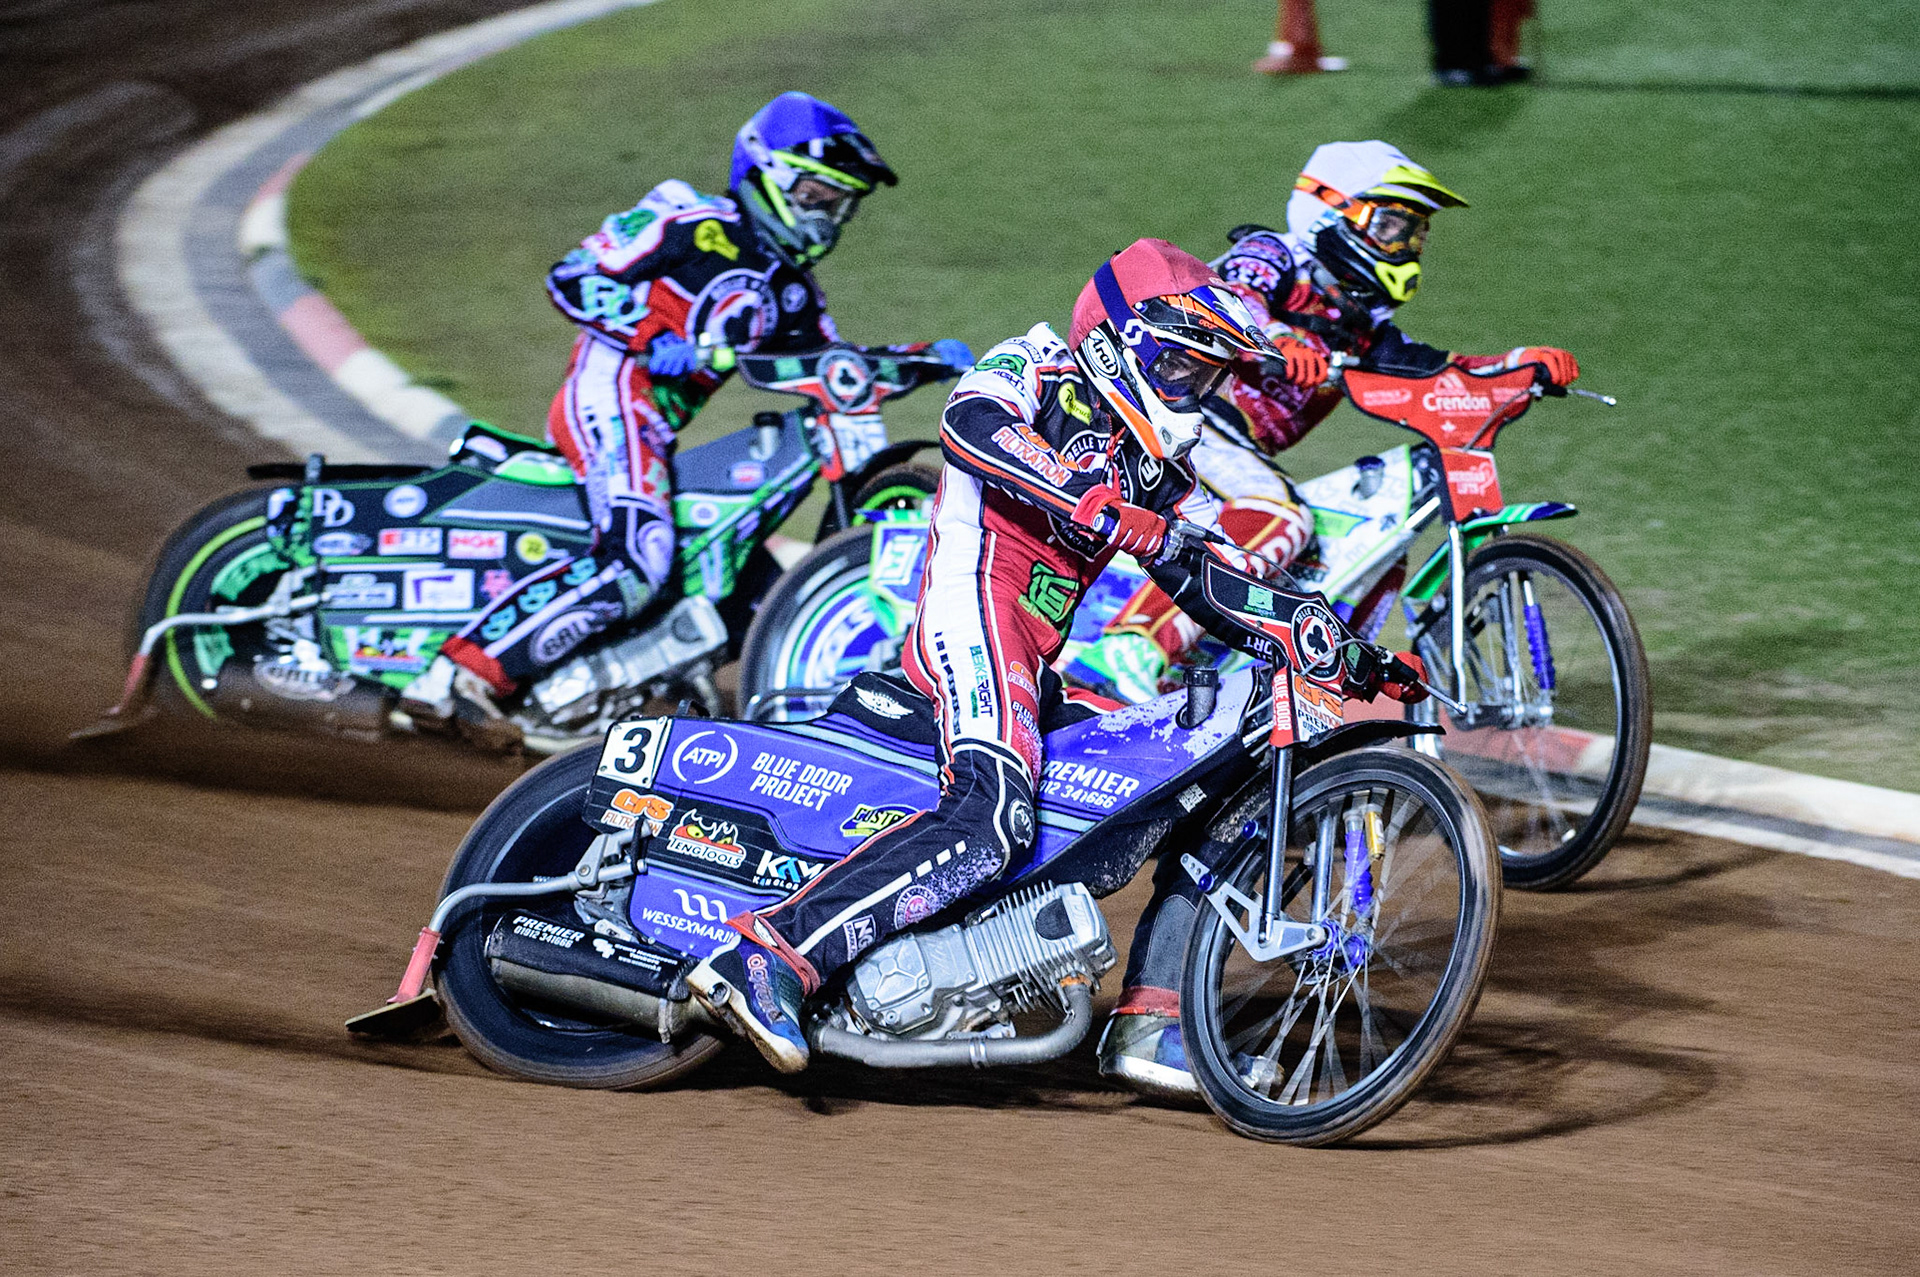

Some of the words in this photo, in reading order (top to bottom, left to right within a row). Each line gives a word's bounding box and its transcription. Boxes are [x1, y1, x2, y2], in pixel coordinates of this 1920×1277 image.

[1092, 336, 1115, 371] Arai
[1422, 391, 1491, 412] Crendon
[992, 428, 1071, 488] FILTRATION
[1273, 674, 1289, 700] BLUE
[1276, 701, 1292, 731] DOOR
[614, 727, 652, 774] 3
[682, 747, 727, 769] ATPI
[751, 751, 800, 781] BLUE
[798, 762, 853, 796] DOOR
[1045, 760, 1140, 799] REMIER
[749, 774, 831, 812] PROJECT
[512, 915, 586, 942] PREMIER
